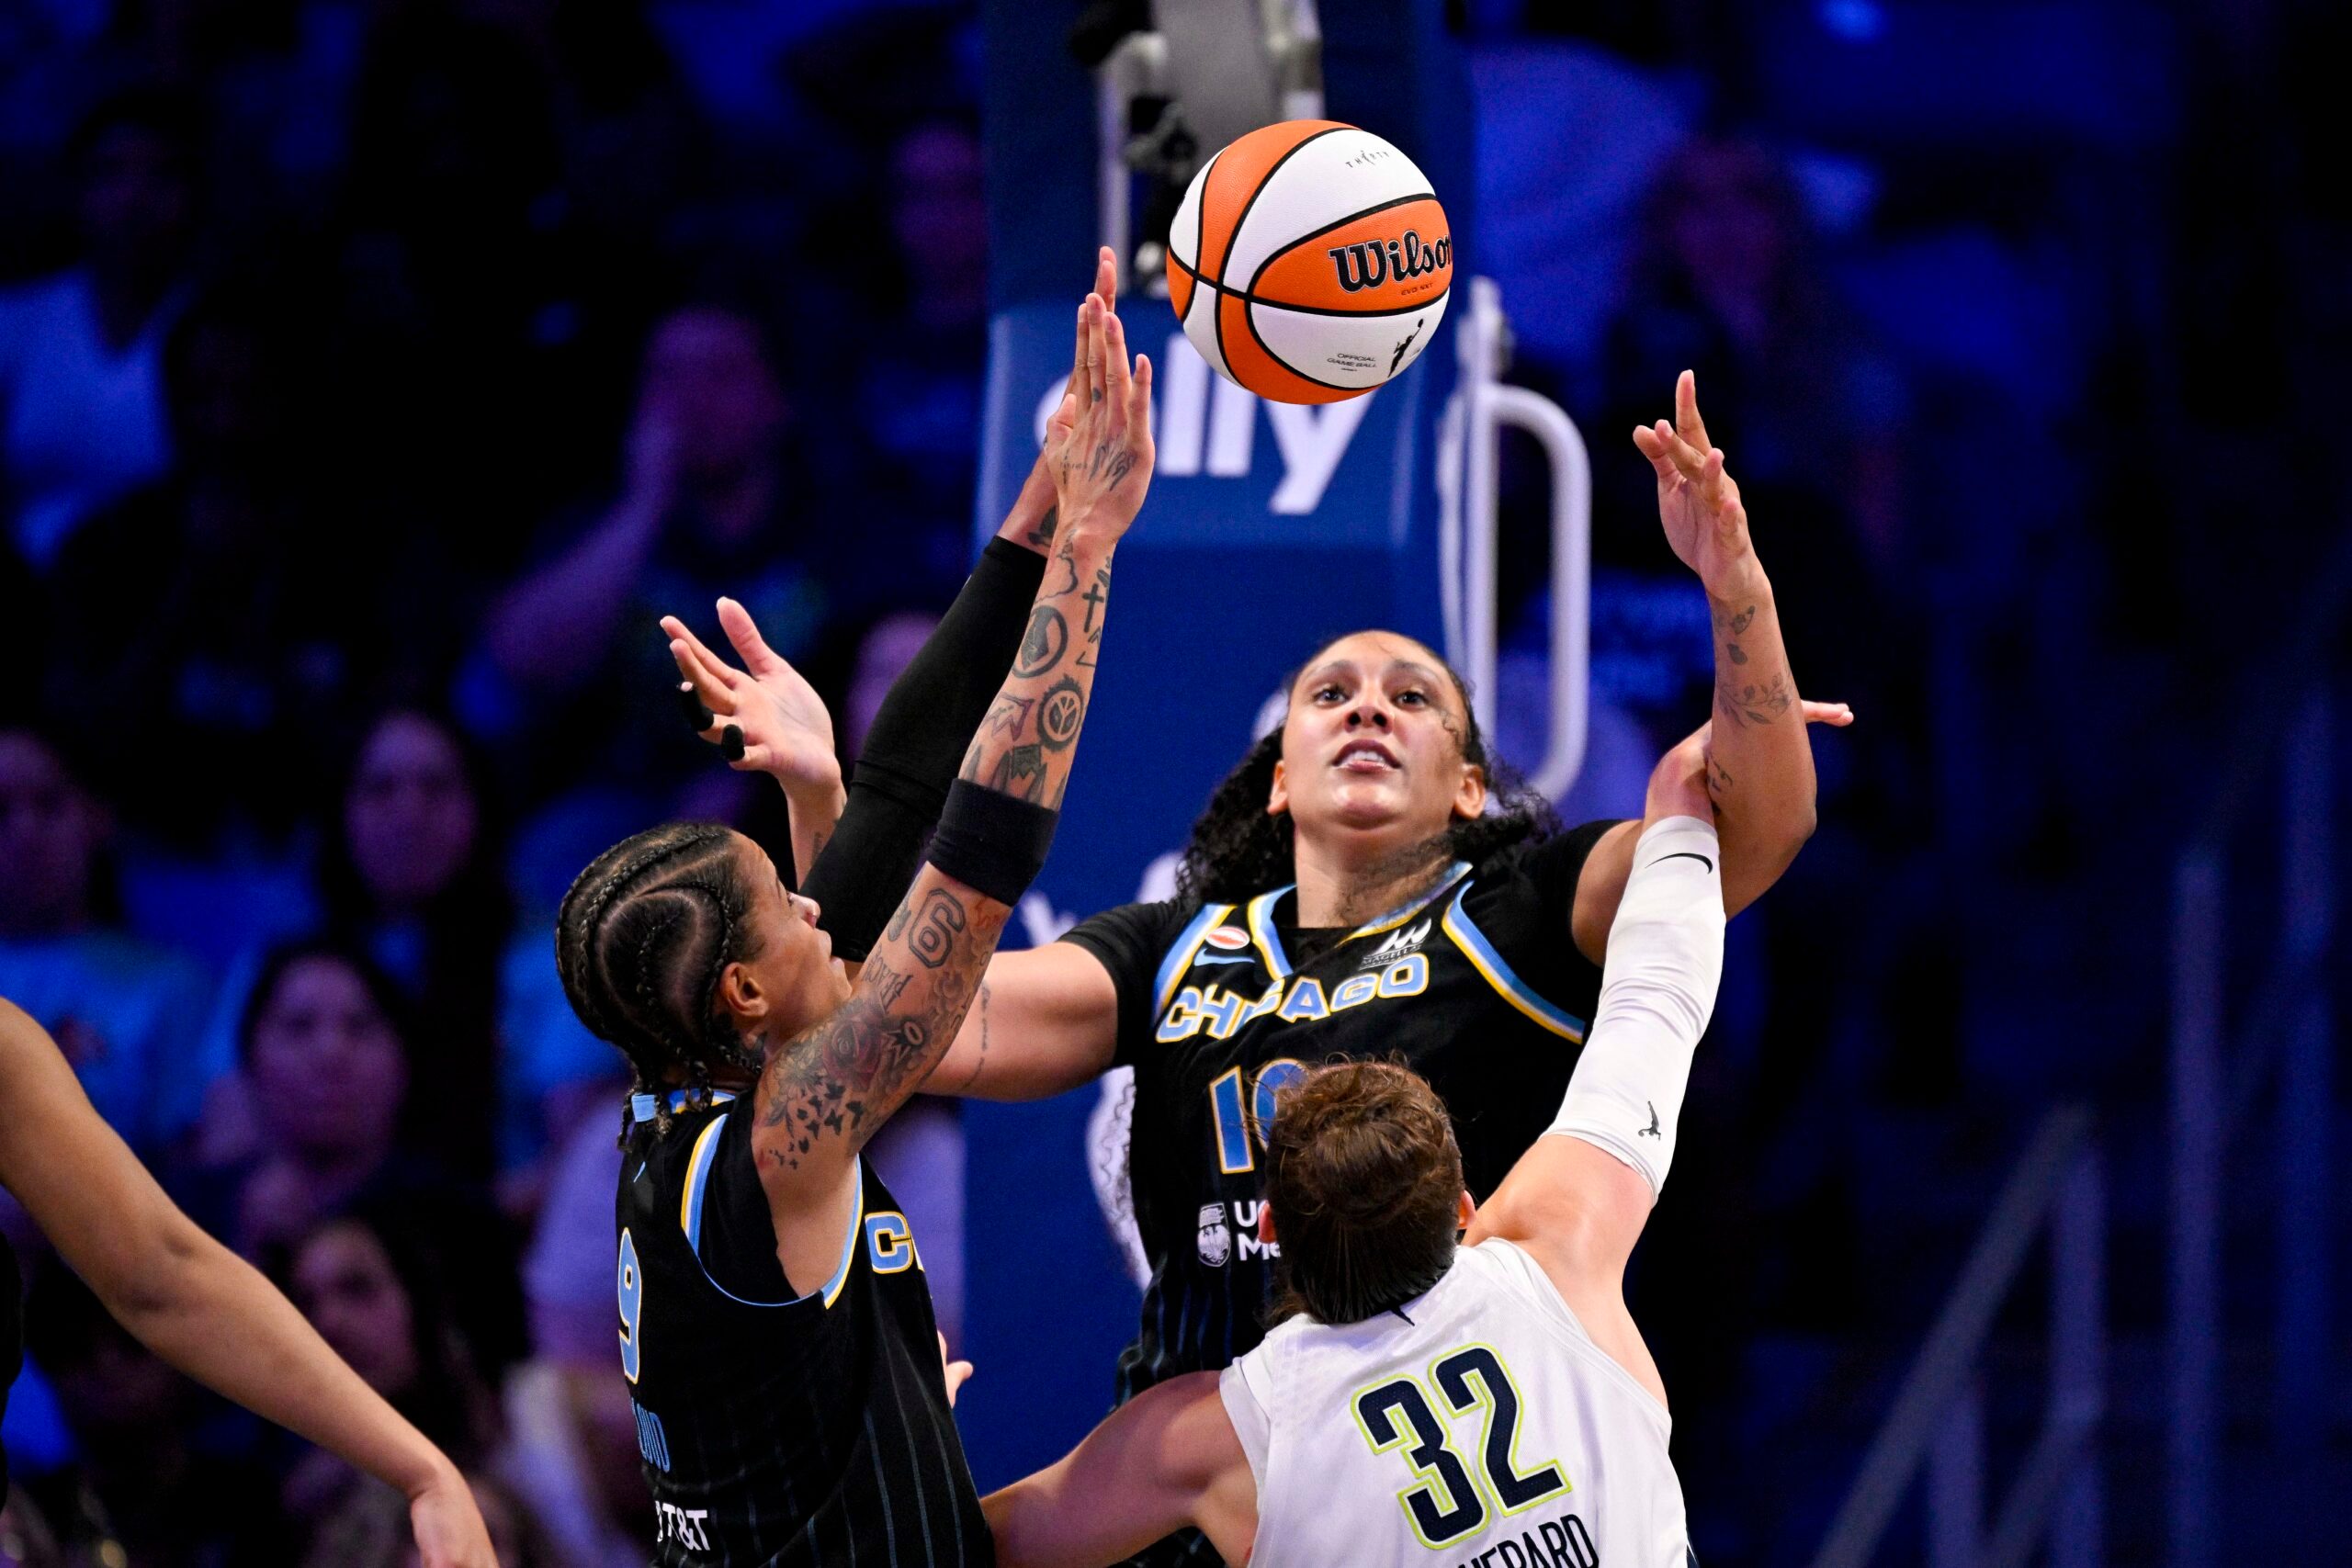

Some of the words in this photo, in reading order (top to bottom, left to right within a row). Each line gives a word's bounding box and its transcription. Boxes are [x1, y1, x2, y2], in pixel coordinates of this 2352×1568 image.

[1327, 357, 1355, 367] GAME
[1337, 353, 1375, 362] OFFICIAL
[1234, 1200, 1269, 1228] U
[865, 1211, 923, 1274] C
[618, 1227, 642, 1384] 9
[1351, 1342, 1573, 1550] 32
